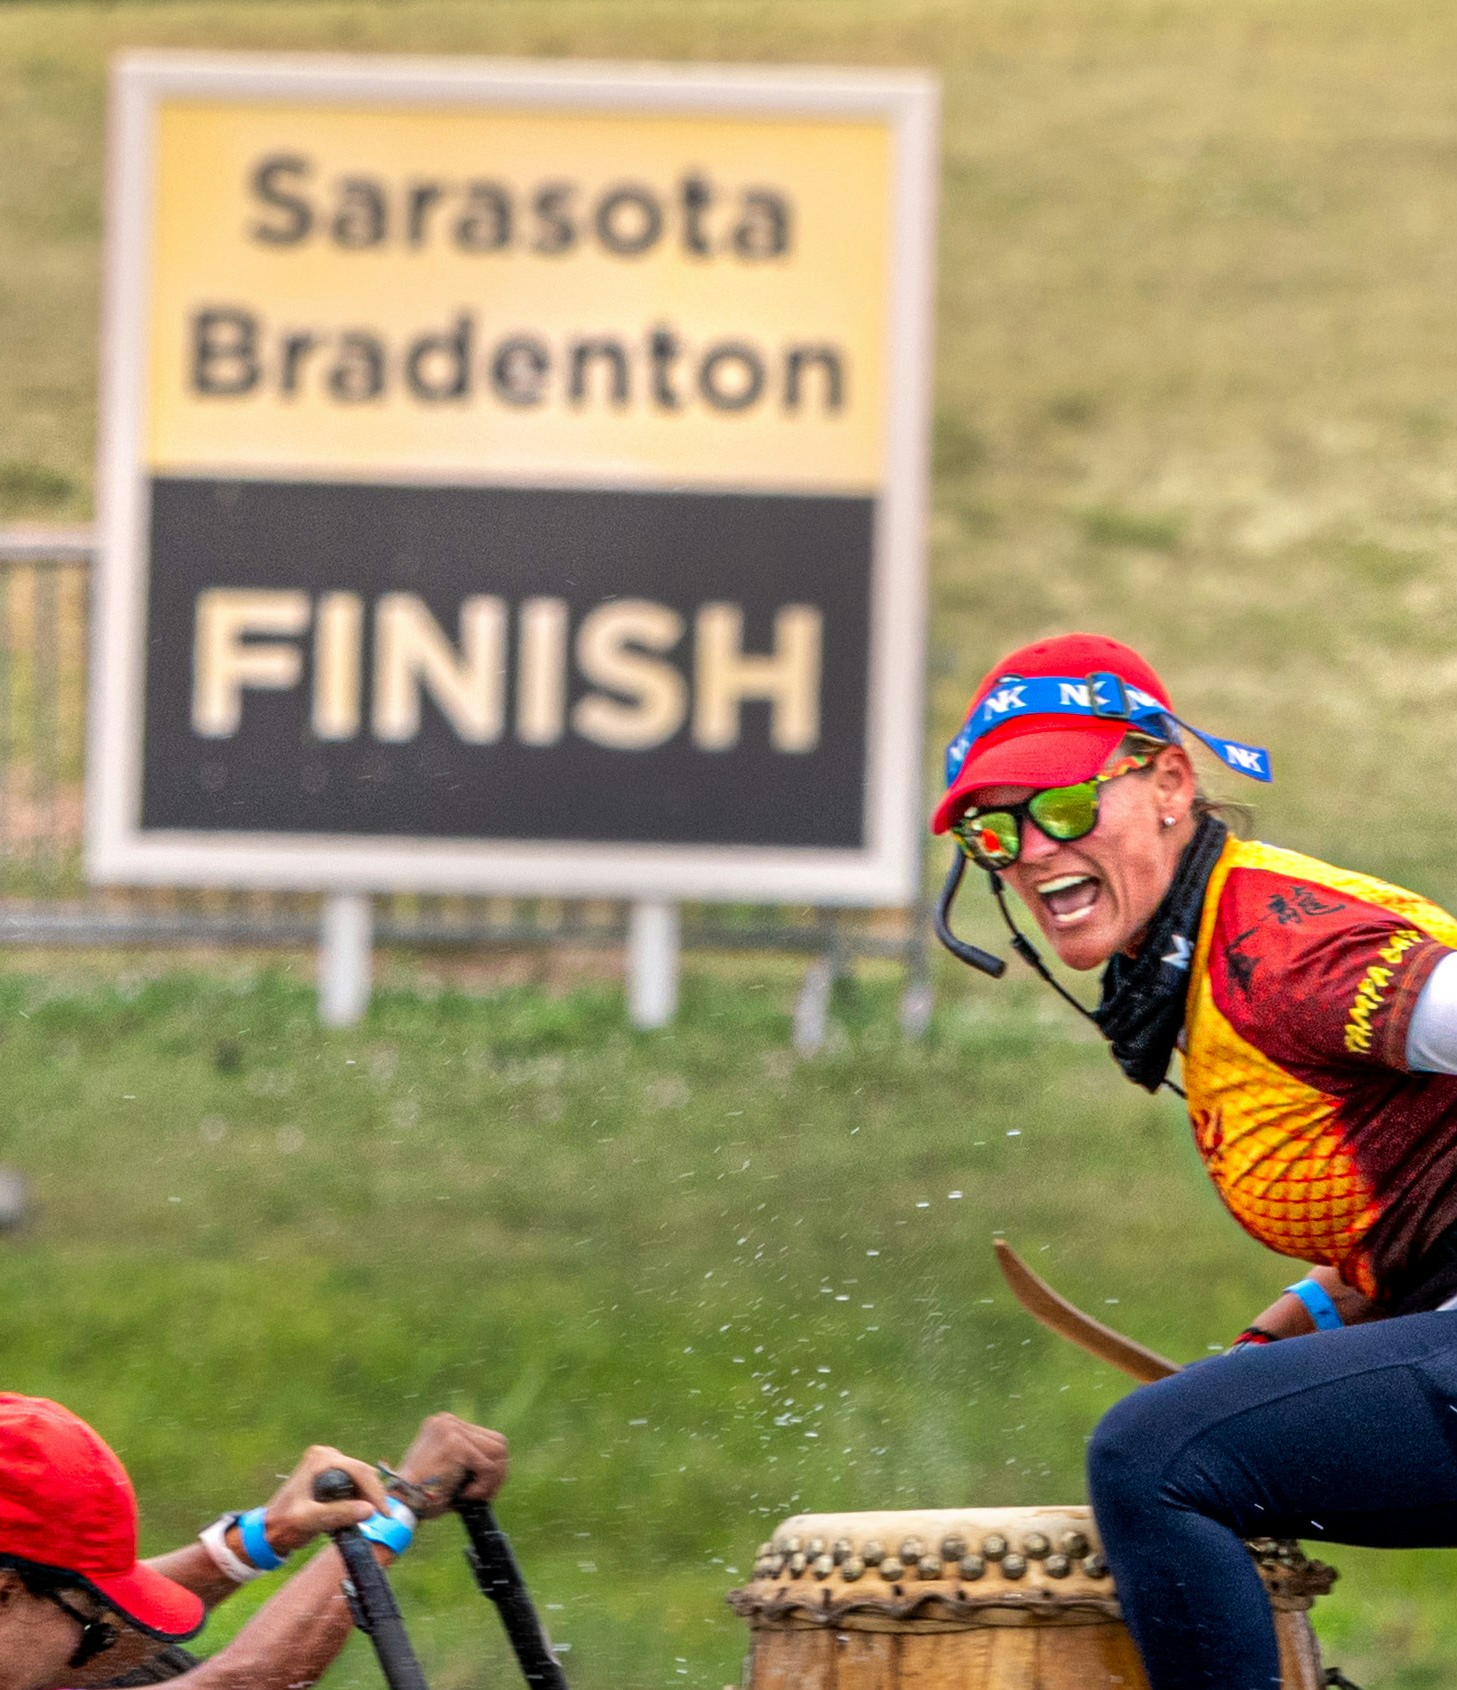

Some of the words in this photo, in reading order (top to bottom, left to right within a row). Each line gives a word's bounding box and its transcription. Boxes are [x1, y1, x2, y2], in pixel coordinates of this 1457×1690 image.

[248, 150, 795, 260] Sarasota
[187, 302, 848, 416] Bradenton
[191, 586, 824, 754] FINISH
[983, 685, 1028, 721] NK
[1057, 681, 1111, 707] NK
[1226, 744, 1265, 773] NK
[1344, 965, 1394, 1054] TAMPA
